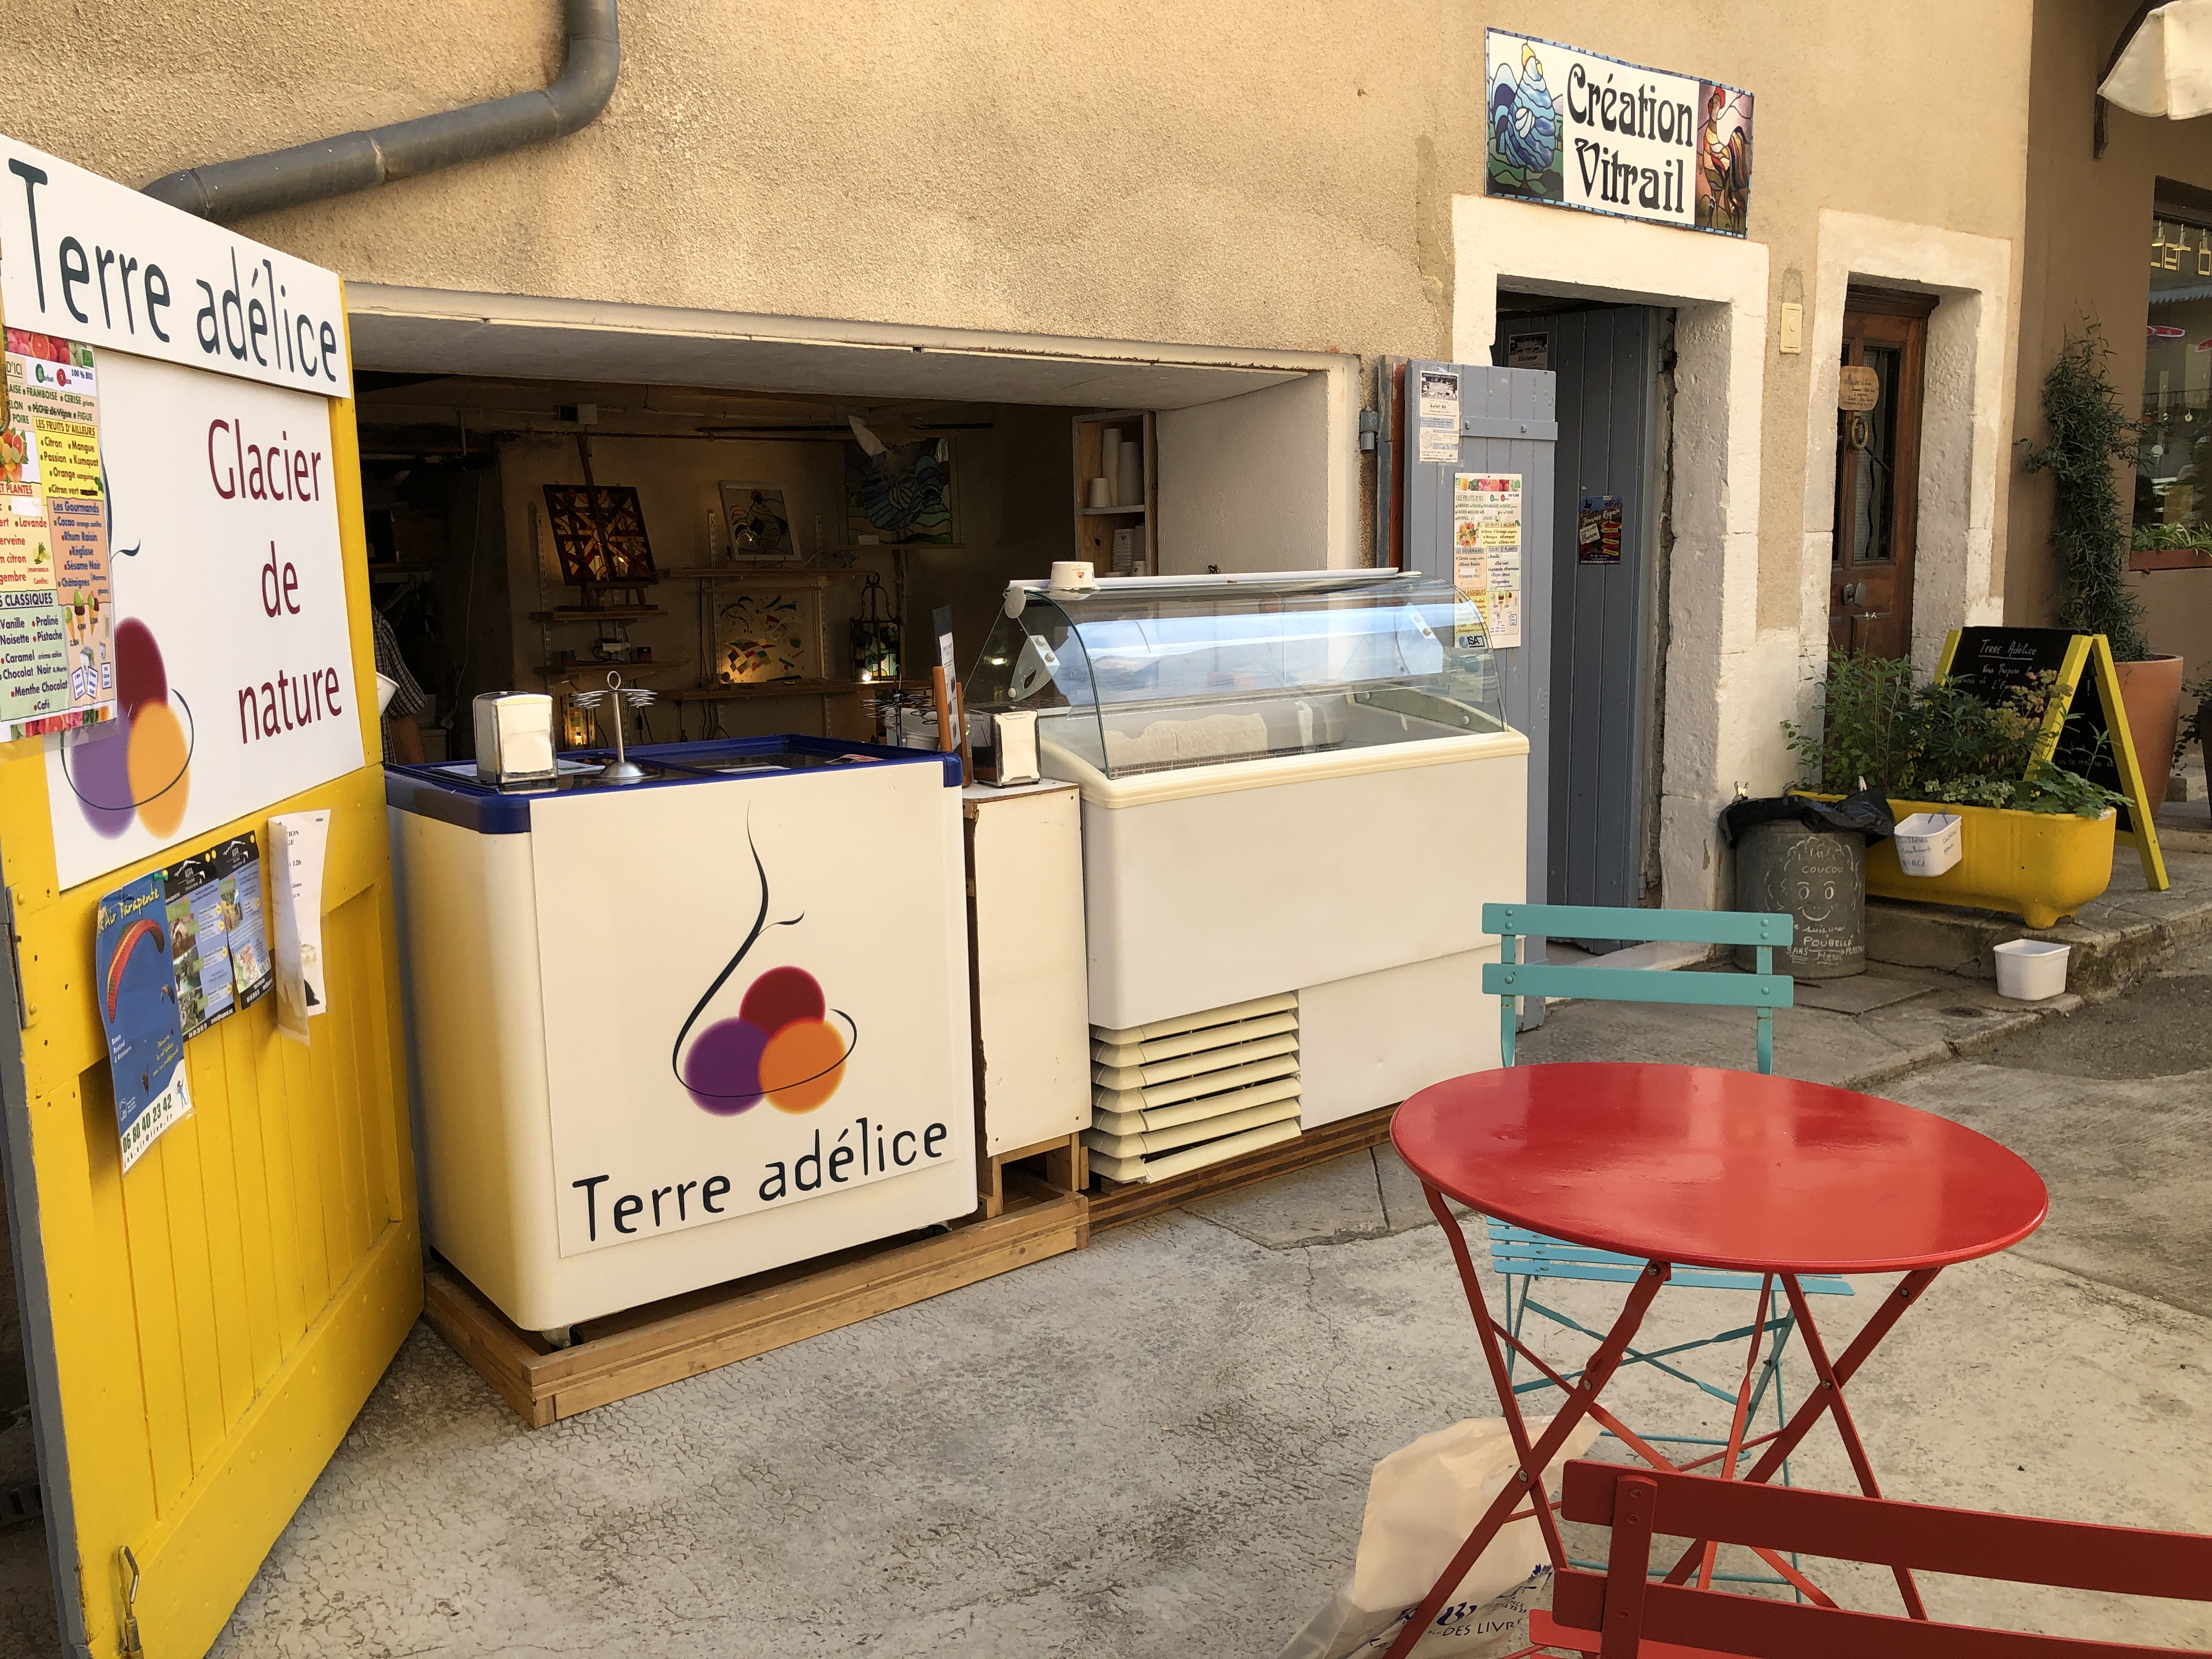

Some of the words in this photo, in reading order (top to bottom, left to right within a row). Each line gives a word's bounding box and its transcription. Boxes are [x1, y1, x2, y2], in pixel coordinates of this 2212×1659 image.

[1566, 63, 1693, 147] Création
[1575, 137, 1684, 213] Vitrail
[8, 157, 171, 343] Terre
[196, 245, 337, 383] adélice
[26, 386, 58, 401] FRAMBOISE
[64, 394, 82, 405] CERISE
[12, 413, 30, 425] POIRE
[77, 411, 93, 421] FIGUE
[35, 419, 44, 429] LES
[46, 420, 65, 432] FRUITS
[65, 423, 95, 436] D'AILLEURS
[44, 436, 63, 448] Citron
[71, 440, 94, 454] Mangue
[43, 450, 66, 464] Passion
[73, 454, 99, 469] Kumquat
[208, 418, 321, 503] Glacier
[53, 466, 75, 481] Orange
[6, 483, 33, 495] PLANTES
[51, 484, 67, 494] Citron
[53, 500, 64, 511] Les
[64, 500, 100, 514] Gourmands
[19, 517, 47, 528] Lavande
[57, 516, 75, 527] Cacao
[64, 530, 81, 541] Rhum
[81, 531, 98, 542] Raisin
[7, 552, 27, 564] citron
[71, 545, 94, 558] Réglisse
[66, 560, 88, 571] Sésame
[89, 560, 101, 571] Noir
[61, 577, 90, 589] Châtaignes
[262, 540, 301, 618] de
[5, 592, 53, 607] CLASSIQUES
[0, 616, 25, 629] Vanille
[36, 614, 59, 627] Praliné
[0, 633, 30, 646] Noisette
[37, 629, 63, 642] Pistache
[5, 649, 35, 664] Caramel
[3, 665, 34, 680] Chocolat
[37, 663, 52, 675] Noir
[15, 682, 40, 697] Menthe
[42, 680, 68, 693] Chocolat
[37, 698, 50, 710] Café
[238, 667, 342, 744] nature
[1801, 865, 1844, 874] COUCOU
[119, 882, 160, 920] Parapente
[122, 1132, 132, 1154] 06
[132, 1122, 141, 1144] 80
[142, 1111, 151, 1132] 40
[153, 1102, 161, 1124] 23
[162, 1093, 172, 1112] 42
[572, 1174, 731, 1242] Terre
[758, 1116, 947, 1201] adélice
[1442, 1624, 1471, 1637] DES
